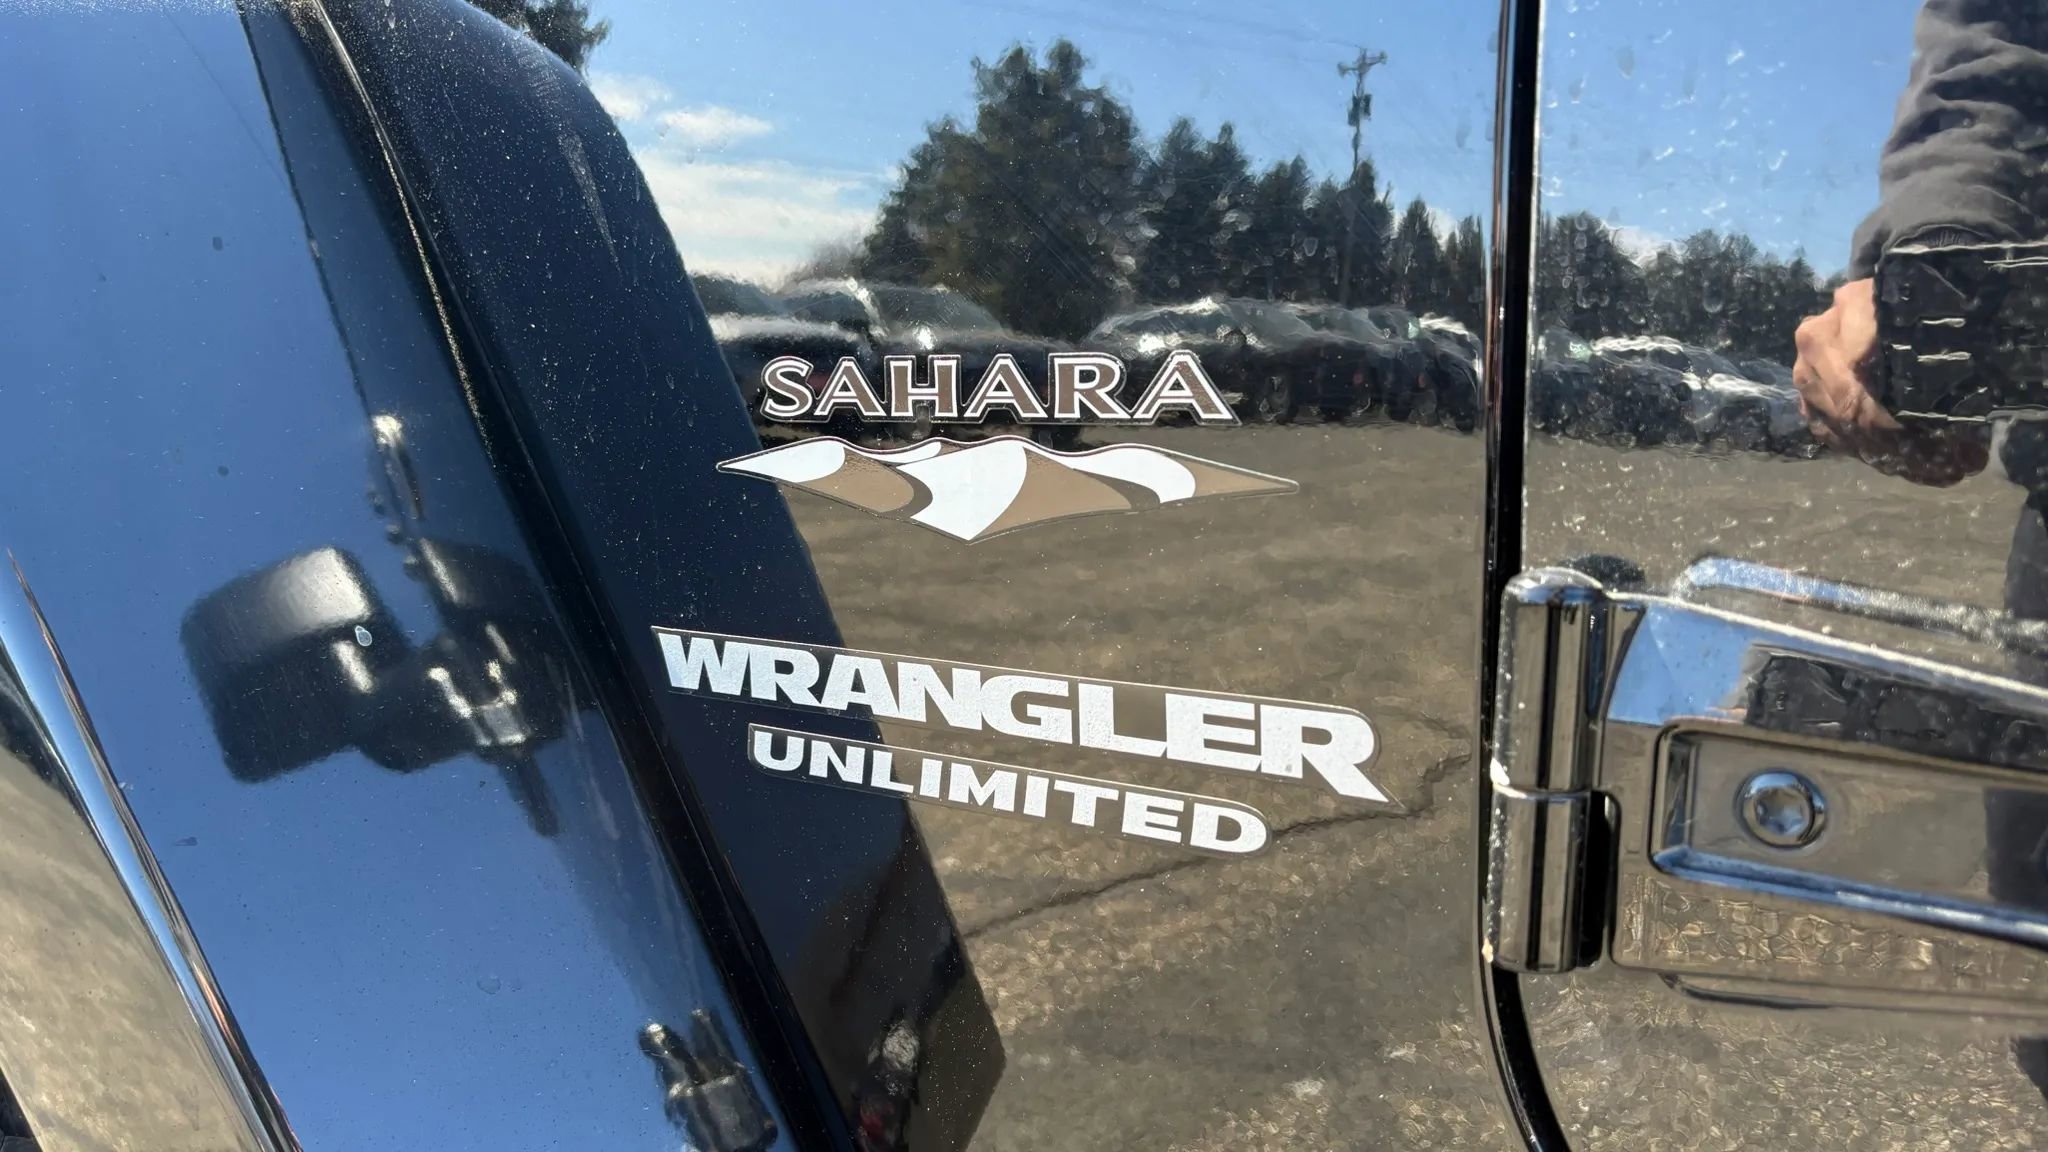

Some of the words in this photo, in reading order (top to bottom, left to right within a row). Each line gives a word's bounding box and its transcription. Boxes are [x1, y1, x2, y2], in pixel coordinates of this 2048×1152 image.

[762, 353, 1238, 421] SAHARA
[658, 633, 1388, 801] WRANGLER
[753, 731, 1267, 853] UNLIMITED
